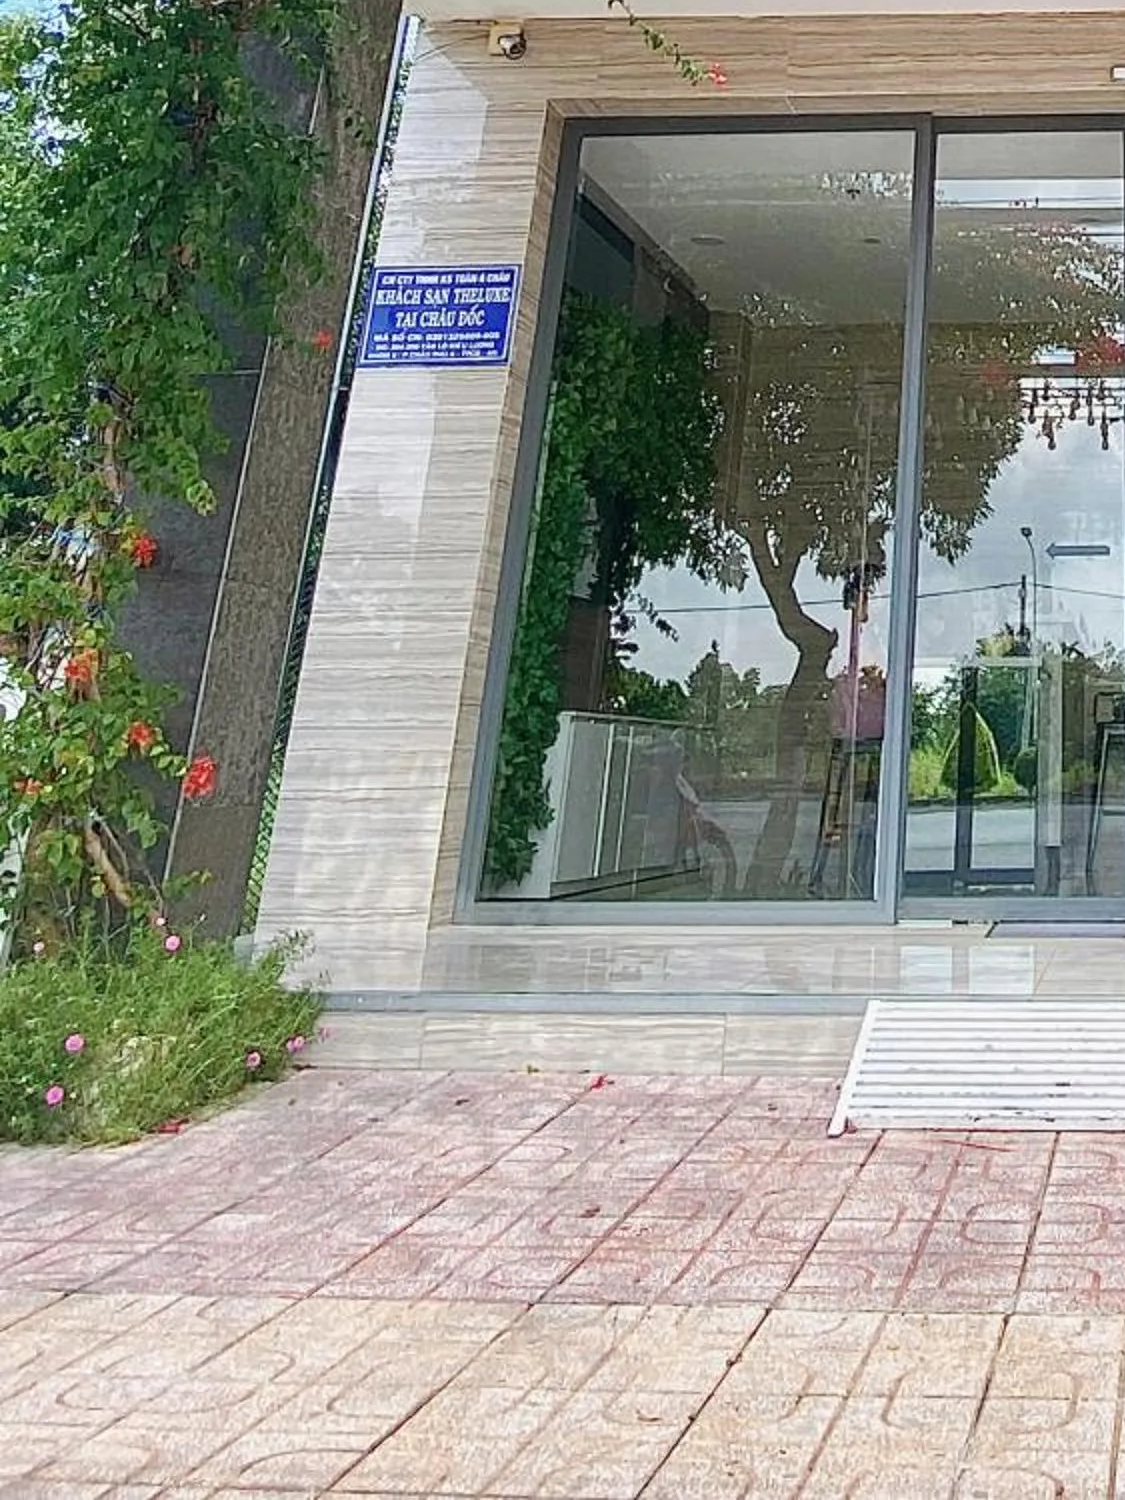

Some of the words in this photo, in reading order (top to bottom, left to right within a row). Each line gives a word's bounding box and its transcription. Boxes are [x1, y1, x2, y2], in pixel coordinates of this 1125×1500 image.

[375, 285, 422, 305] KHÁCH
[424, 288, 450, 307] SẠN
[453, 287, 511, 304] THELUXE
[420, 308, 456, 328] CHÂU
